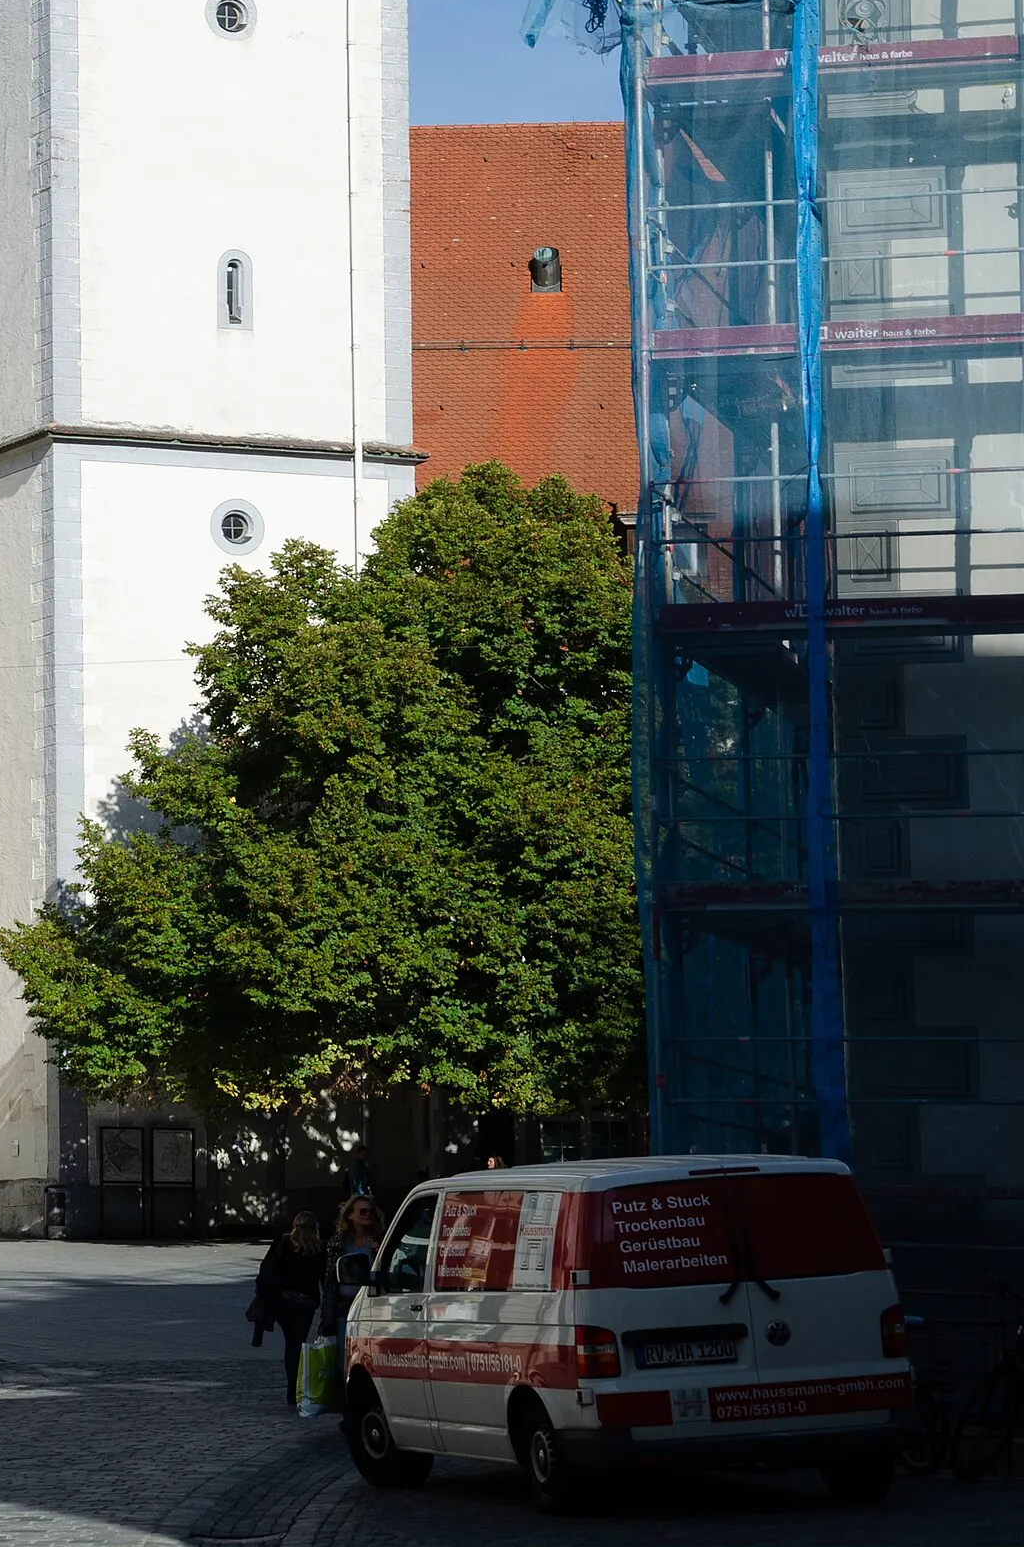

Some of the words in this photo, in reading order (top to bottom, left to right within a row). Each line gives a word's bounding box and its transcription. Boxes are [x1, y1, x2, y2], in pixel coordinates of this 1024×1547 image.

[611, 1200, 647, 1214] Putz
[651, 1198, 663, 1211] &
[666, 1193, 712, 1209] Stuck
[520, 1225, 553, 1237] Haussmann
[614, 1215, 706, 1234] Trockenbau
[619, 1236, 701, 1253] Gerüstbau
[622, 1254, 728, 1274] Malerarbeiten
[372, 1350, 466, 1373] www.haussmann-gmbh.com
[471, 1353, 522, 1373] 0751/56181-0
[645, 1345, 665, 1362] RV
[715, 1376, 905, 1402] www.haussmann-gmbh.com
[716, 1400, 807, 1419] 0751/56181-0
